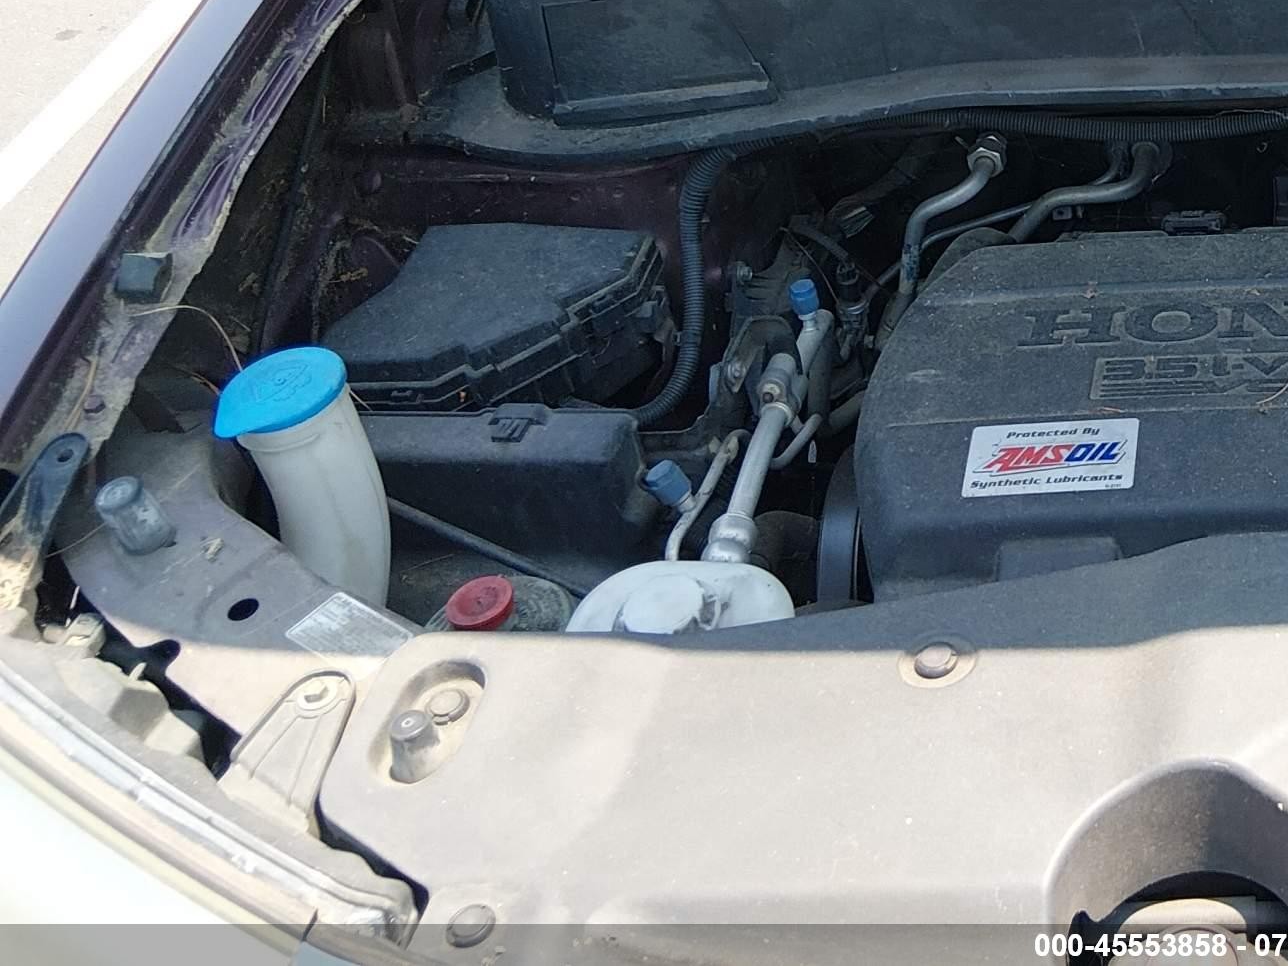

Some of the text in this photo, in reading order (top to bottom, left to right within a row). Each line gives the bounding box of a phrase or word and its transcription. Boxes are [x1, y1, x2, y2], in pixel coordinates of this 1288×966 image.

[1102, 356, 1199, 381] 3.5
[1006, 427, 1101, 439] Protected By
[983, 441, 1124, 473] AMSOIL
[970, 473, 1123, 490] Synthetic Lubricants
